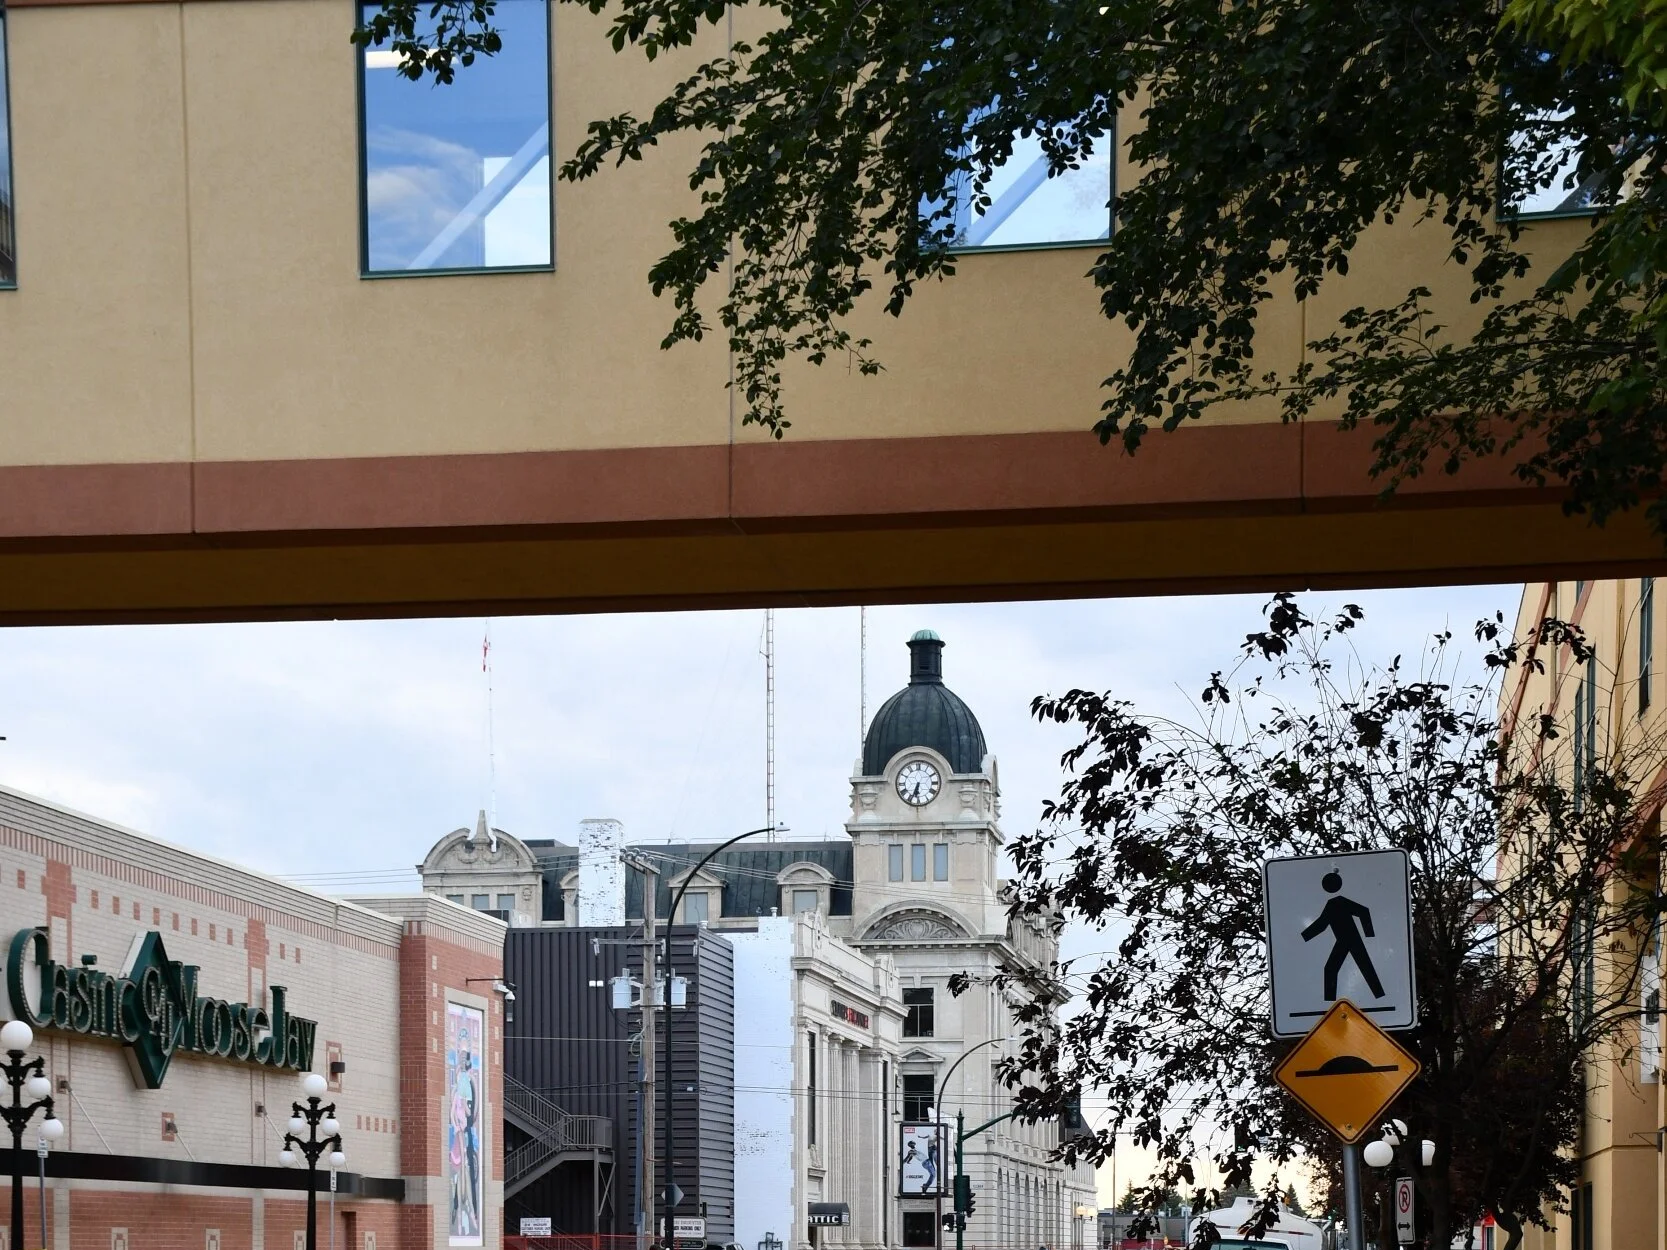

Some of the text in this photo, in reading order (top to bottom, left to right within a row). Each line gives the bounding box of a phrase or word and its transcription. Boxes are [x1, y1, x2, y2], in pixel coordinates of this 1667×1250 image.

[7, 926, 319, 1072] Casino Moose Jaw
